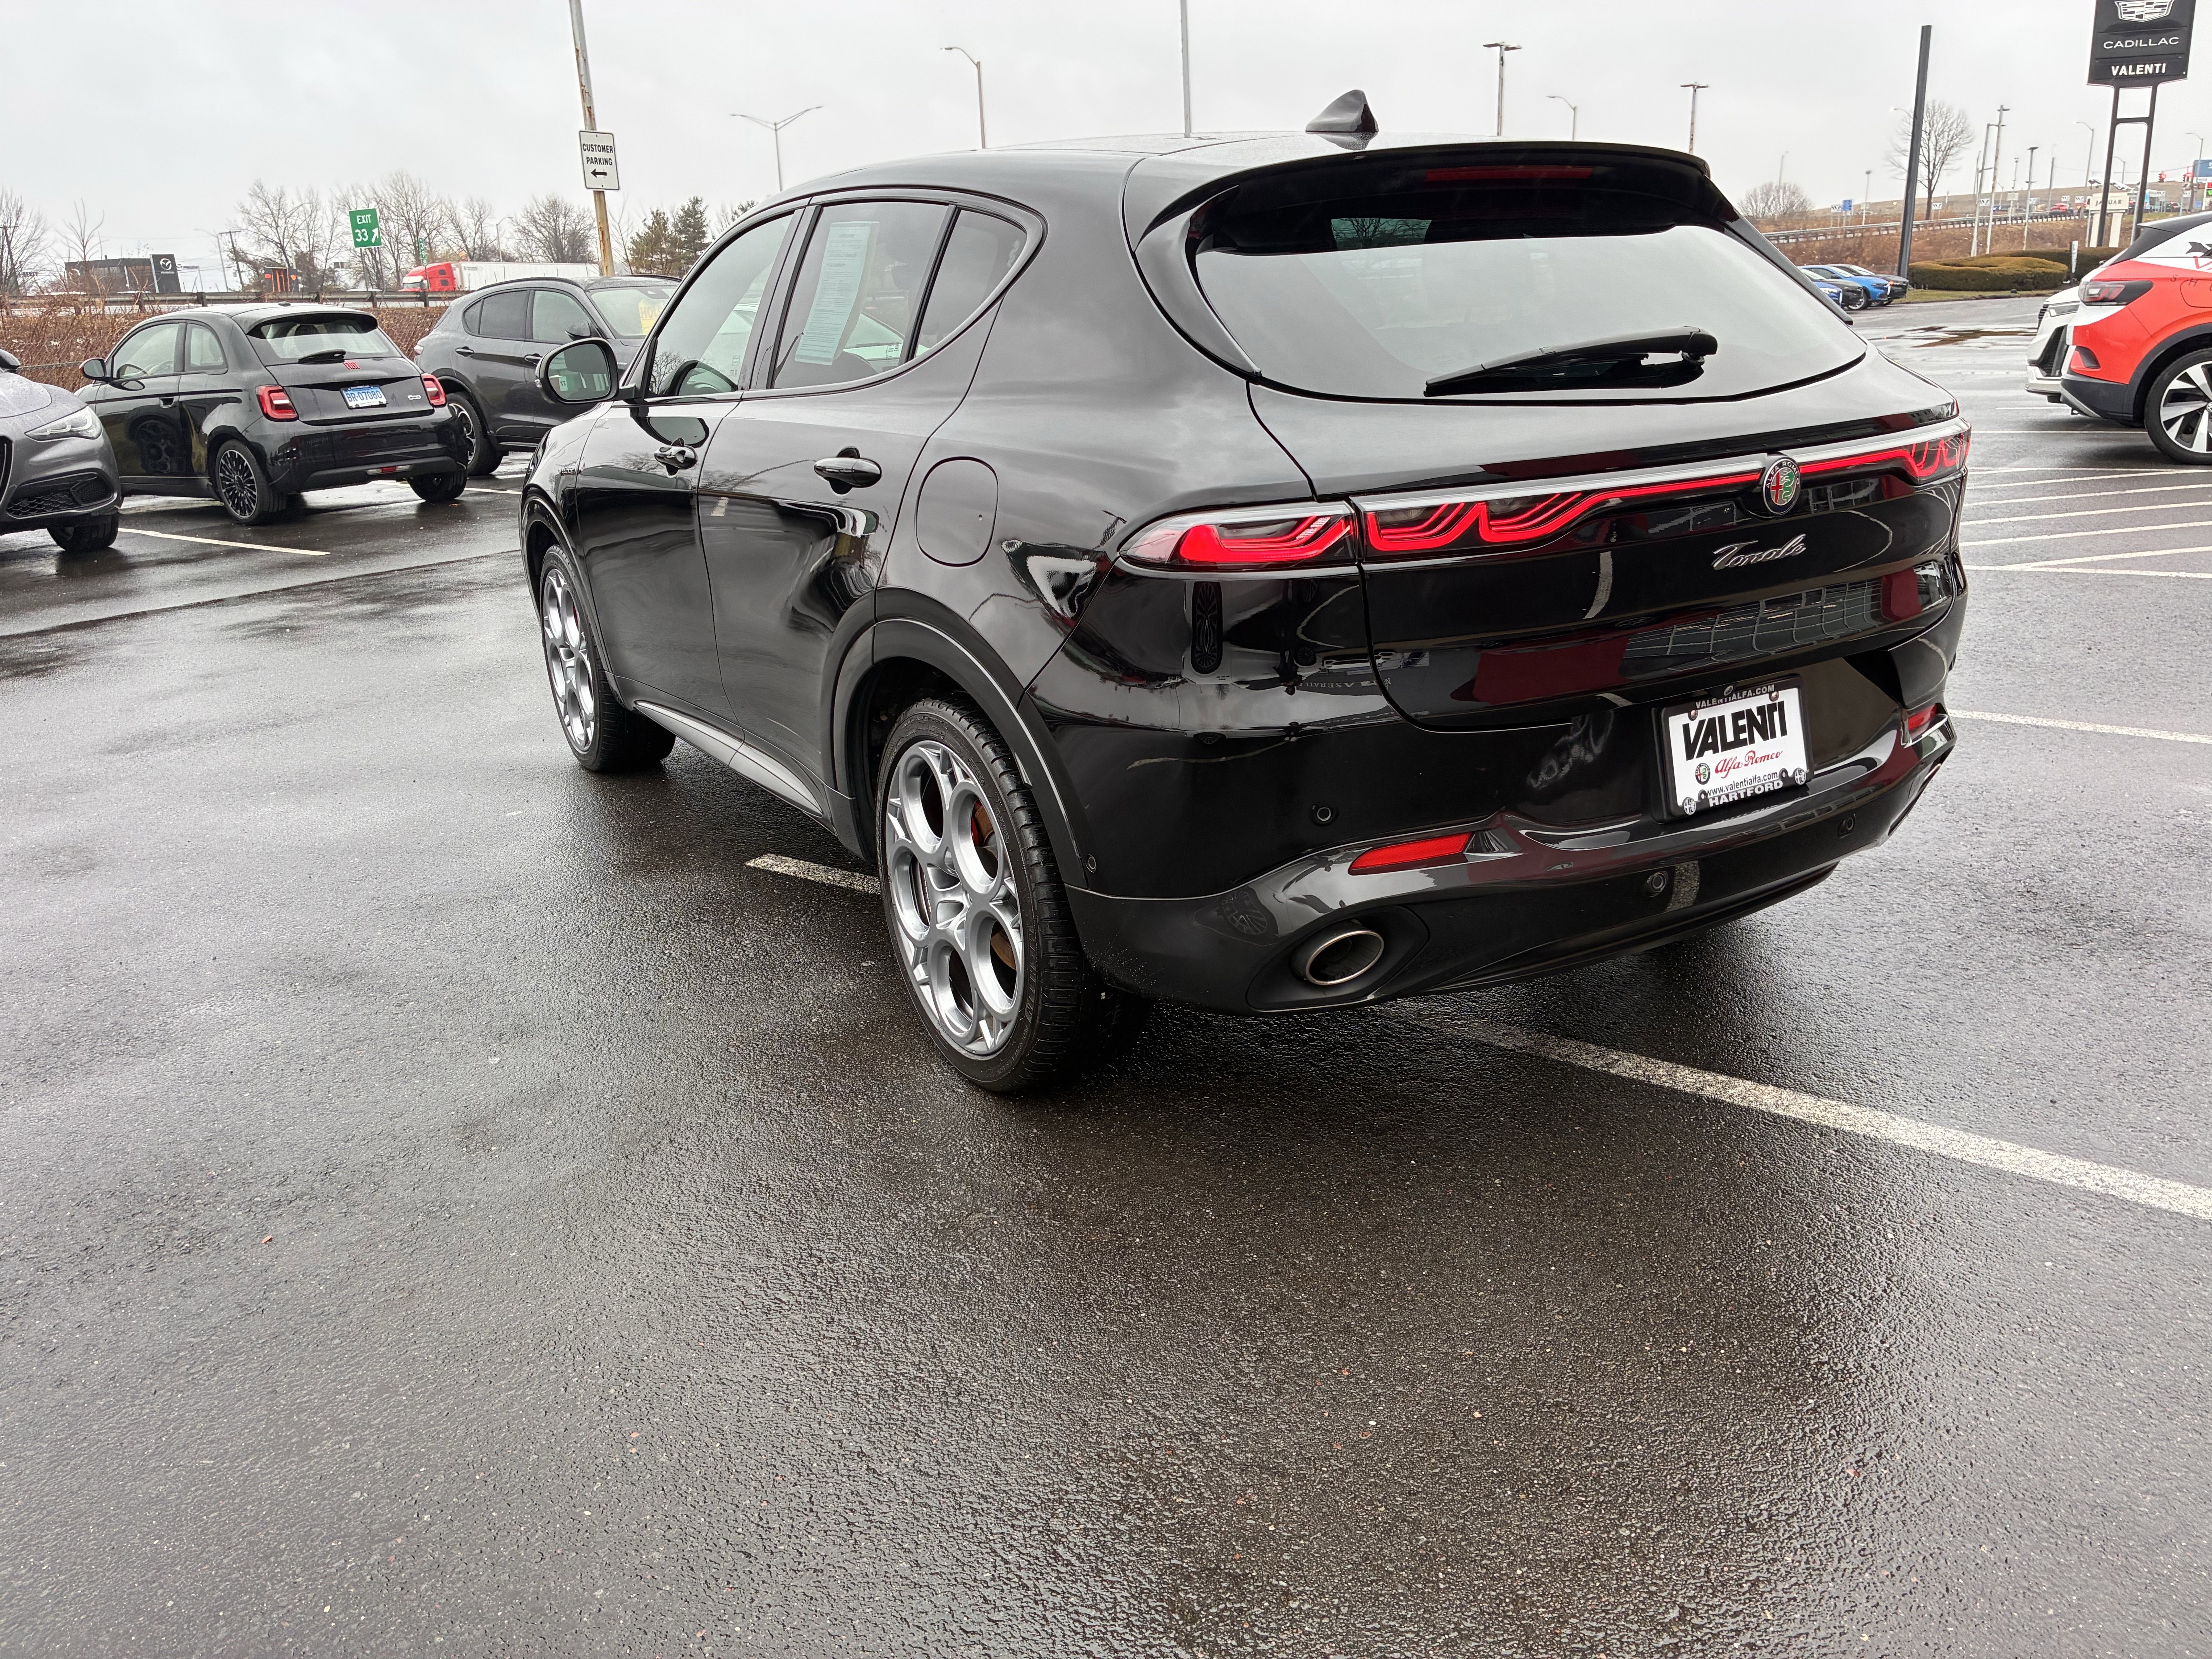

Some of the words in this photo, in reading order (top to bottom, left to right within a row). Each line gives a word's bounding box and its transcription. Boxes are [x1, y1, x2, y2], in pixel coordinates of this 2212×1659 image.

[2103, 37, 2179, 49] CADILLAC
[2111, 63, 2166, 76] VALENTI
[582, 143, 613, 153] CUSTOMER
[586, 156, 613, 166] PARKING
[356, 214, 371, 224] EXIT
[355, 228, 369, 242] 33
[1766, 465, 1780, 488] ALFA
[1711, 534, 1806, 570] Tonale
[1682, 700, 1788, 761] VALENTI
[1715, 756, 1743, 779] Alfa
[1744, 750, 1783, 767] Romeo
[1707, 771, 1778, 796] www.valentialfa.com
[1709, 780, 1783, 807] HARTFORD
